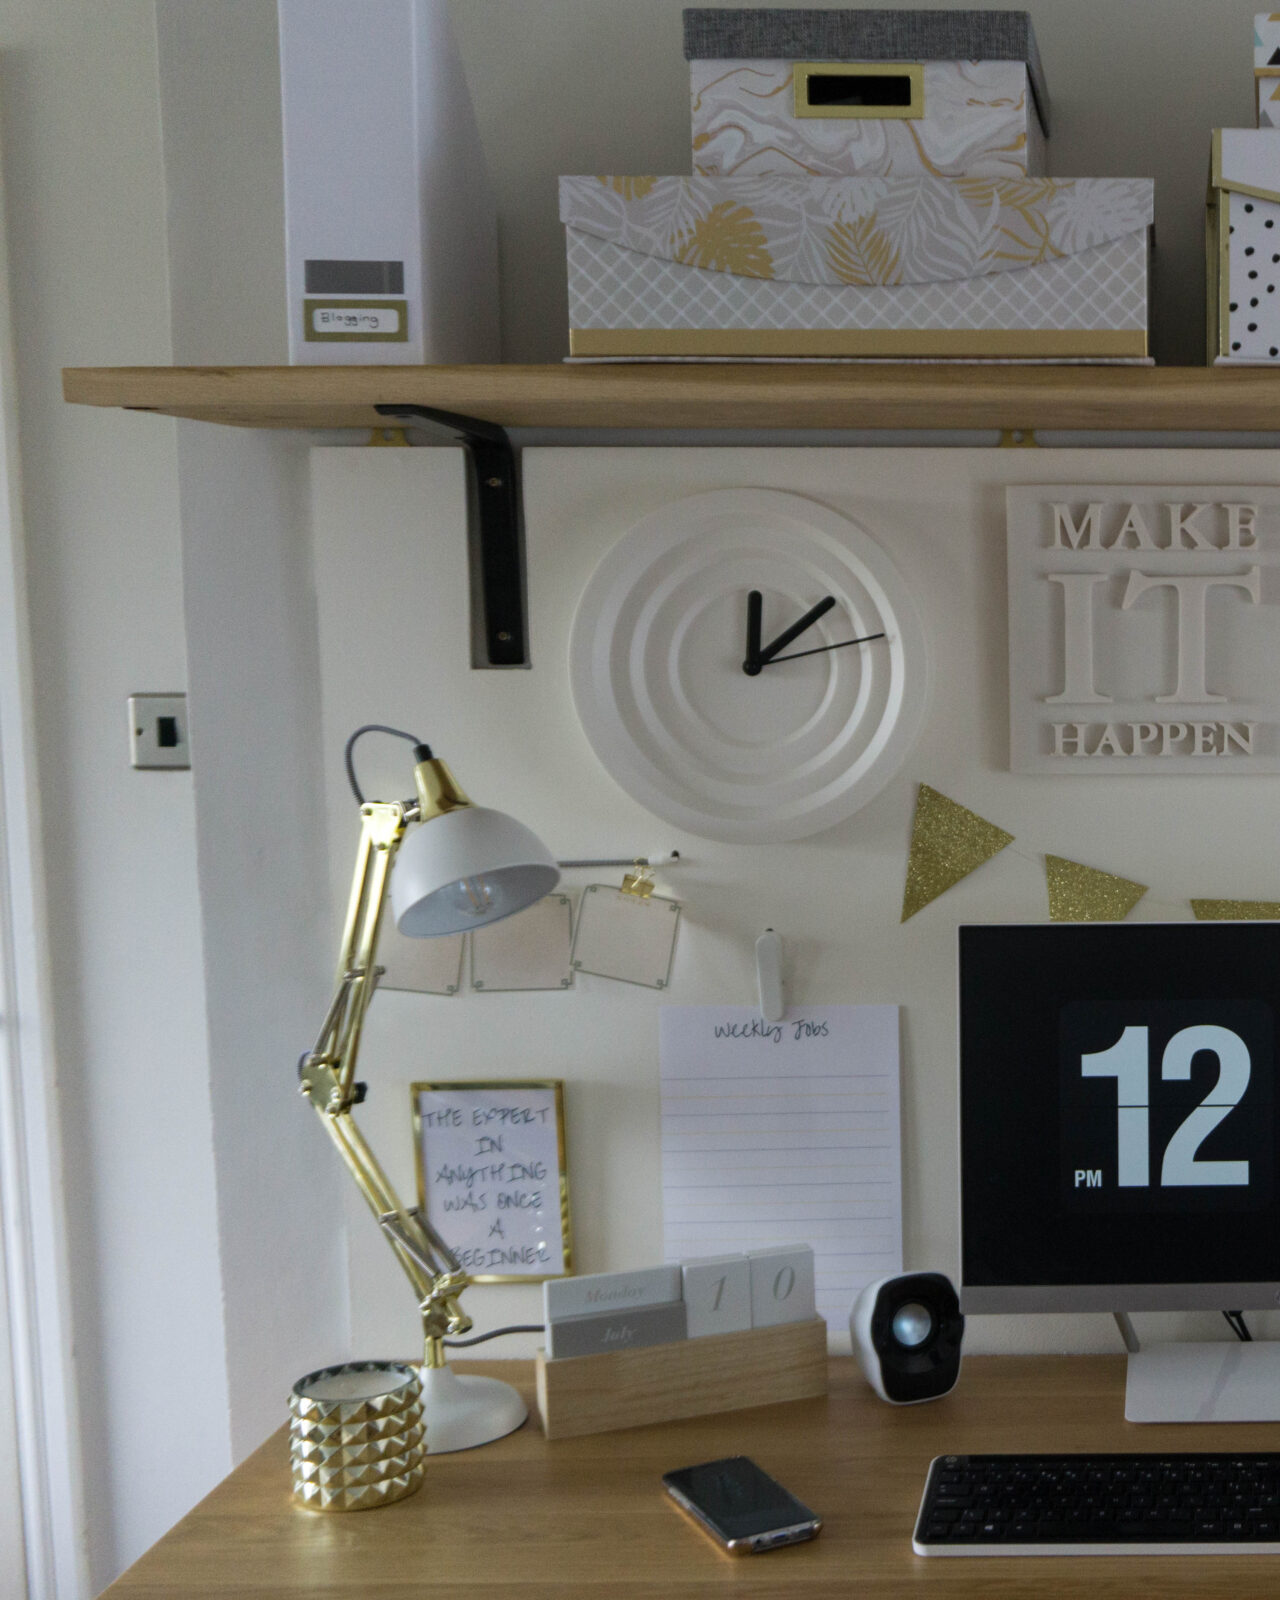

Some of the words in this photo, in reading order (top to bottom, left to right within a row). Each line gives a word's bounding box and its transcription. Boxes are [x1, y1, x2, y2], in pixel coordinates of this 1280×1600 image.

[320, 311, 379, 329] Blogging
[1048, 502, 1259, 550] MAKE
[1045, 565, 1261, 703] IT
[1049, 721, 1259, 757] HAPPEN
[791, 1018, 830, 1040] Jobs
[421, 1108, 462, 1127] THE
[472, 1106, 550, 1126] EXPERT
[1081, 1024, 1252, 1187] 12
[474, 1134, 503, 1157] IN
[1074, 1169, 1102, 1188] PM
[443, 1191, 488, 1212] WAS
[496, 1190, 543, 1210] ONCE
[488, 1217, 505, 1240] A
[585, 1284, 646, 1303] Monday
[601, 1326, 637, 1343] July
